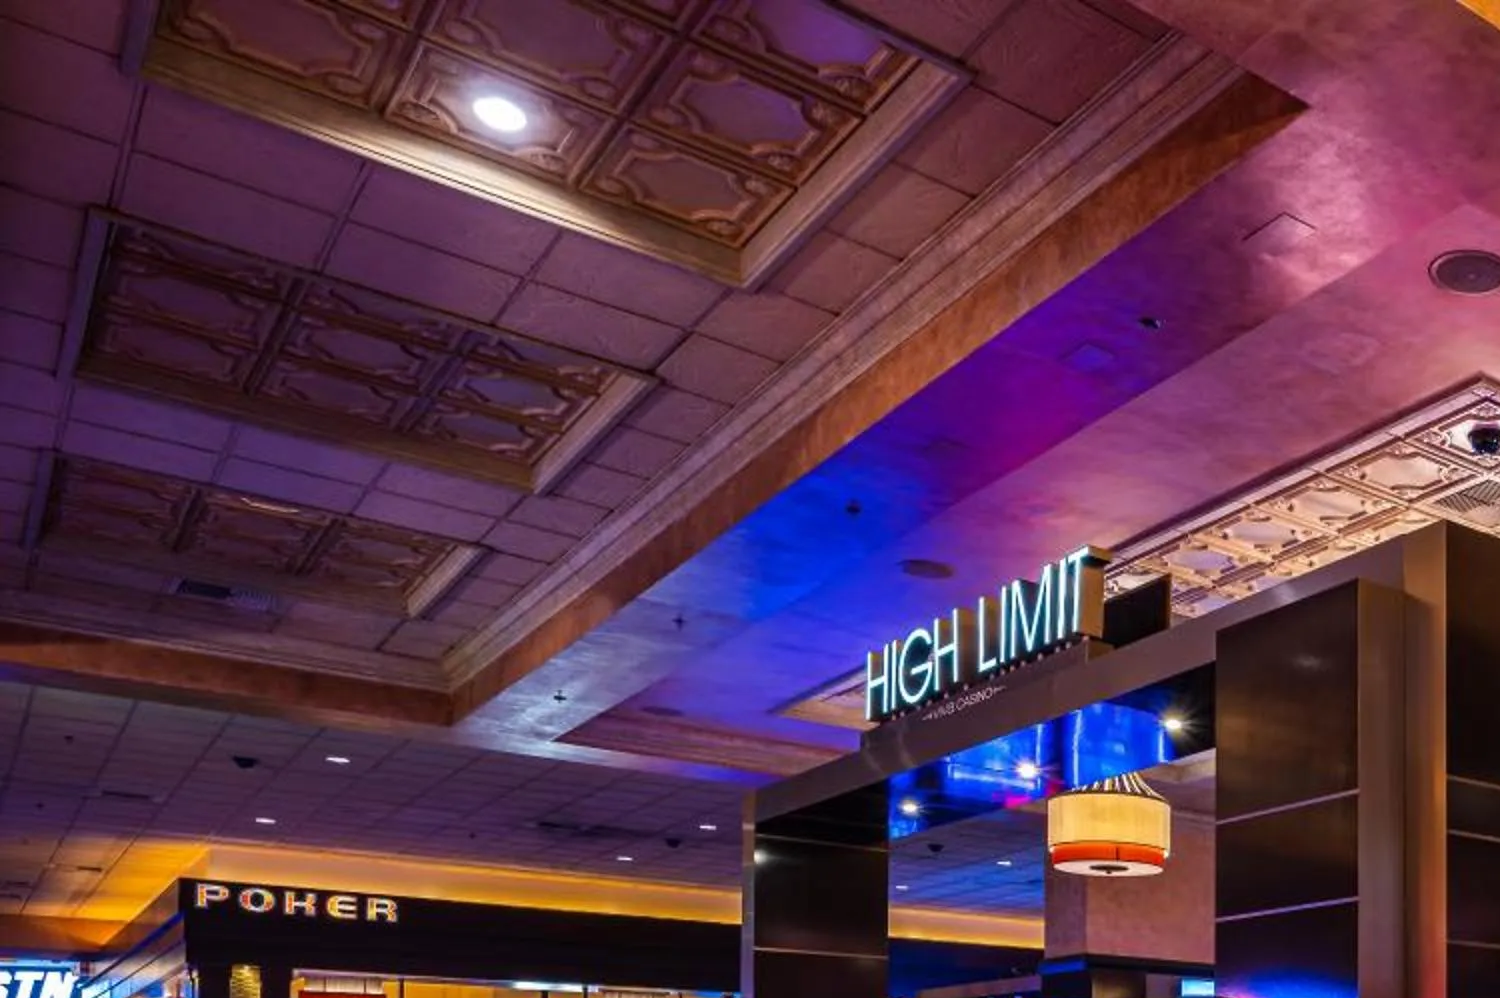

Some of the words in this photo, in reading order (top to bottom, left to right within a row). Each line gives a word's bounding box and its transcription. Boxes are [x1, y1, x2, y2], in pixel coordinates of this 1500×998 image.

[864, 606, 958, 721] HIGH
[978, 546, 1090, 672] LIMIT
[194, 882, 399, 923] POKER
